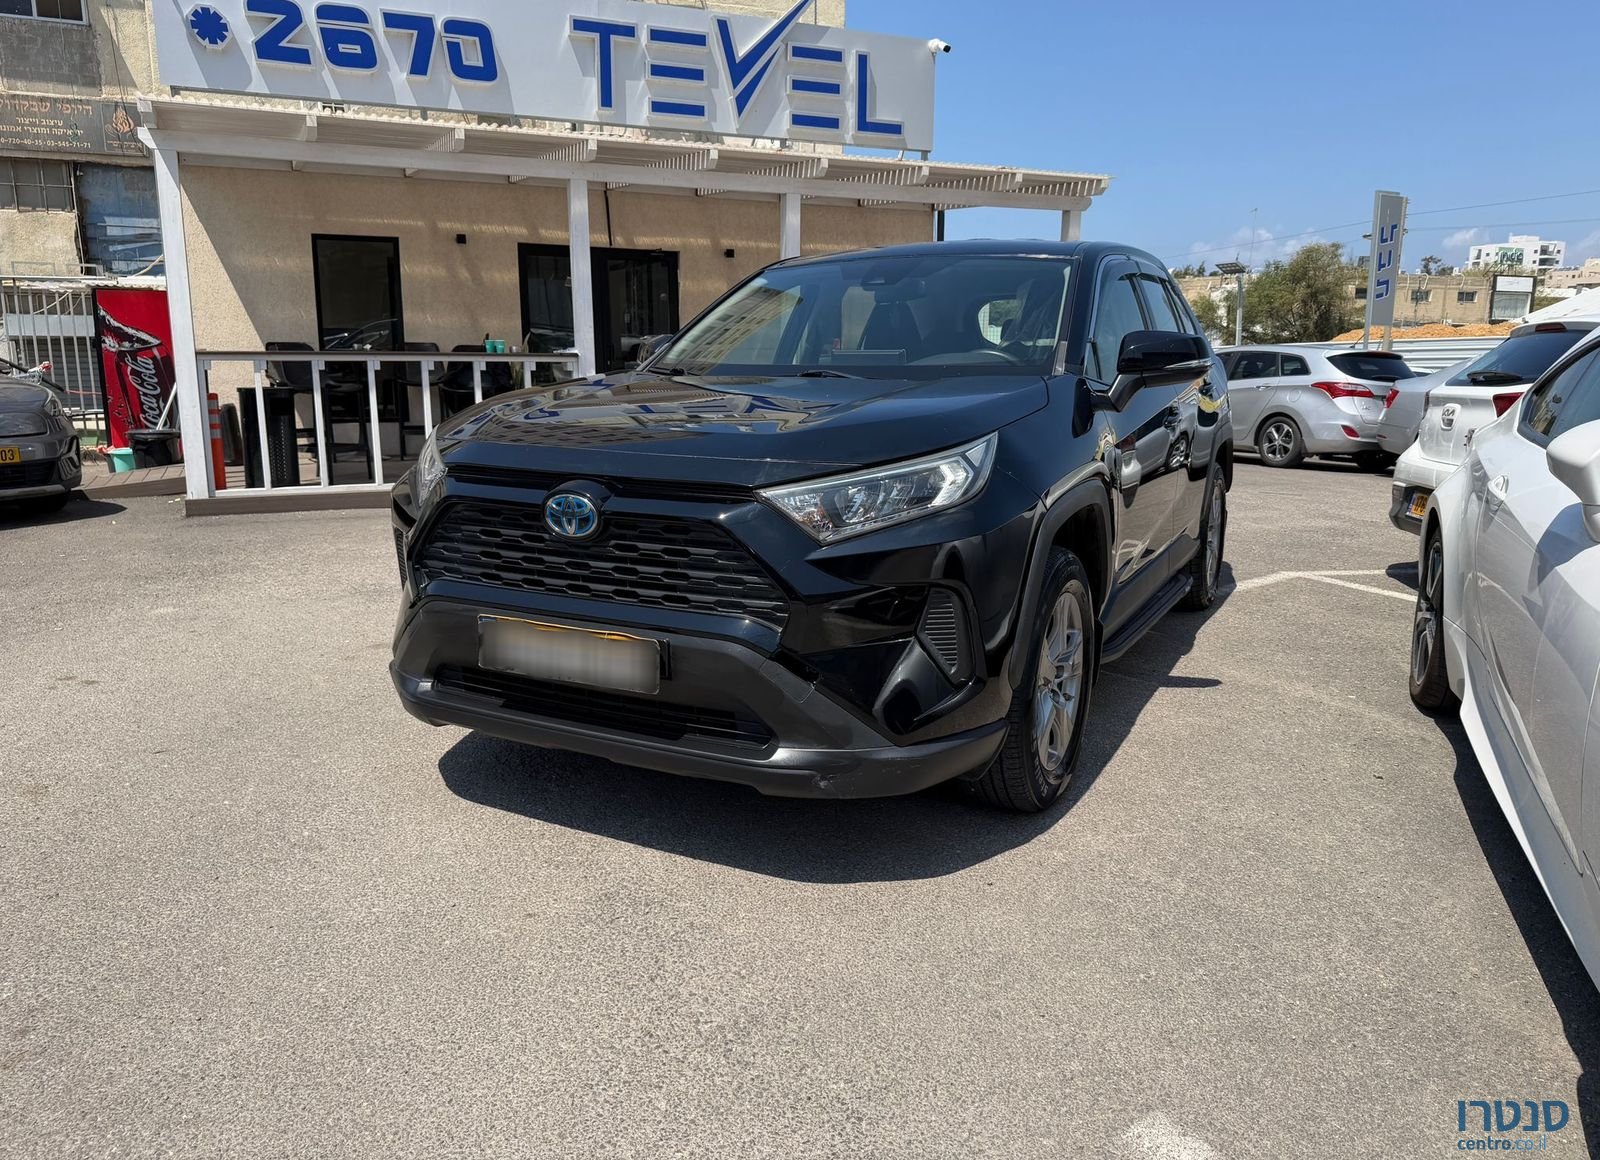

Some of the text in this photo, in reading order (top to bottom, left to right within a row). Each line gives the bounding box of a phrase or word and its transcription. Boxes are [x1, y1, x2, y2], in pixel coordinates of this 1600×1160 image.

[571, 0, 905, 136] TEVEL
[16, 117, 63, 126] עיצוב וייצור
